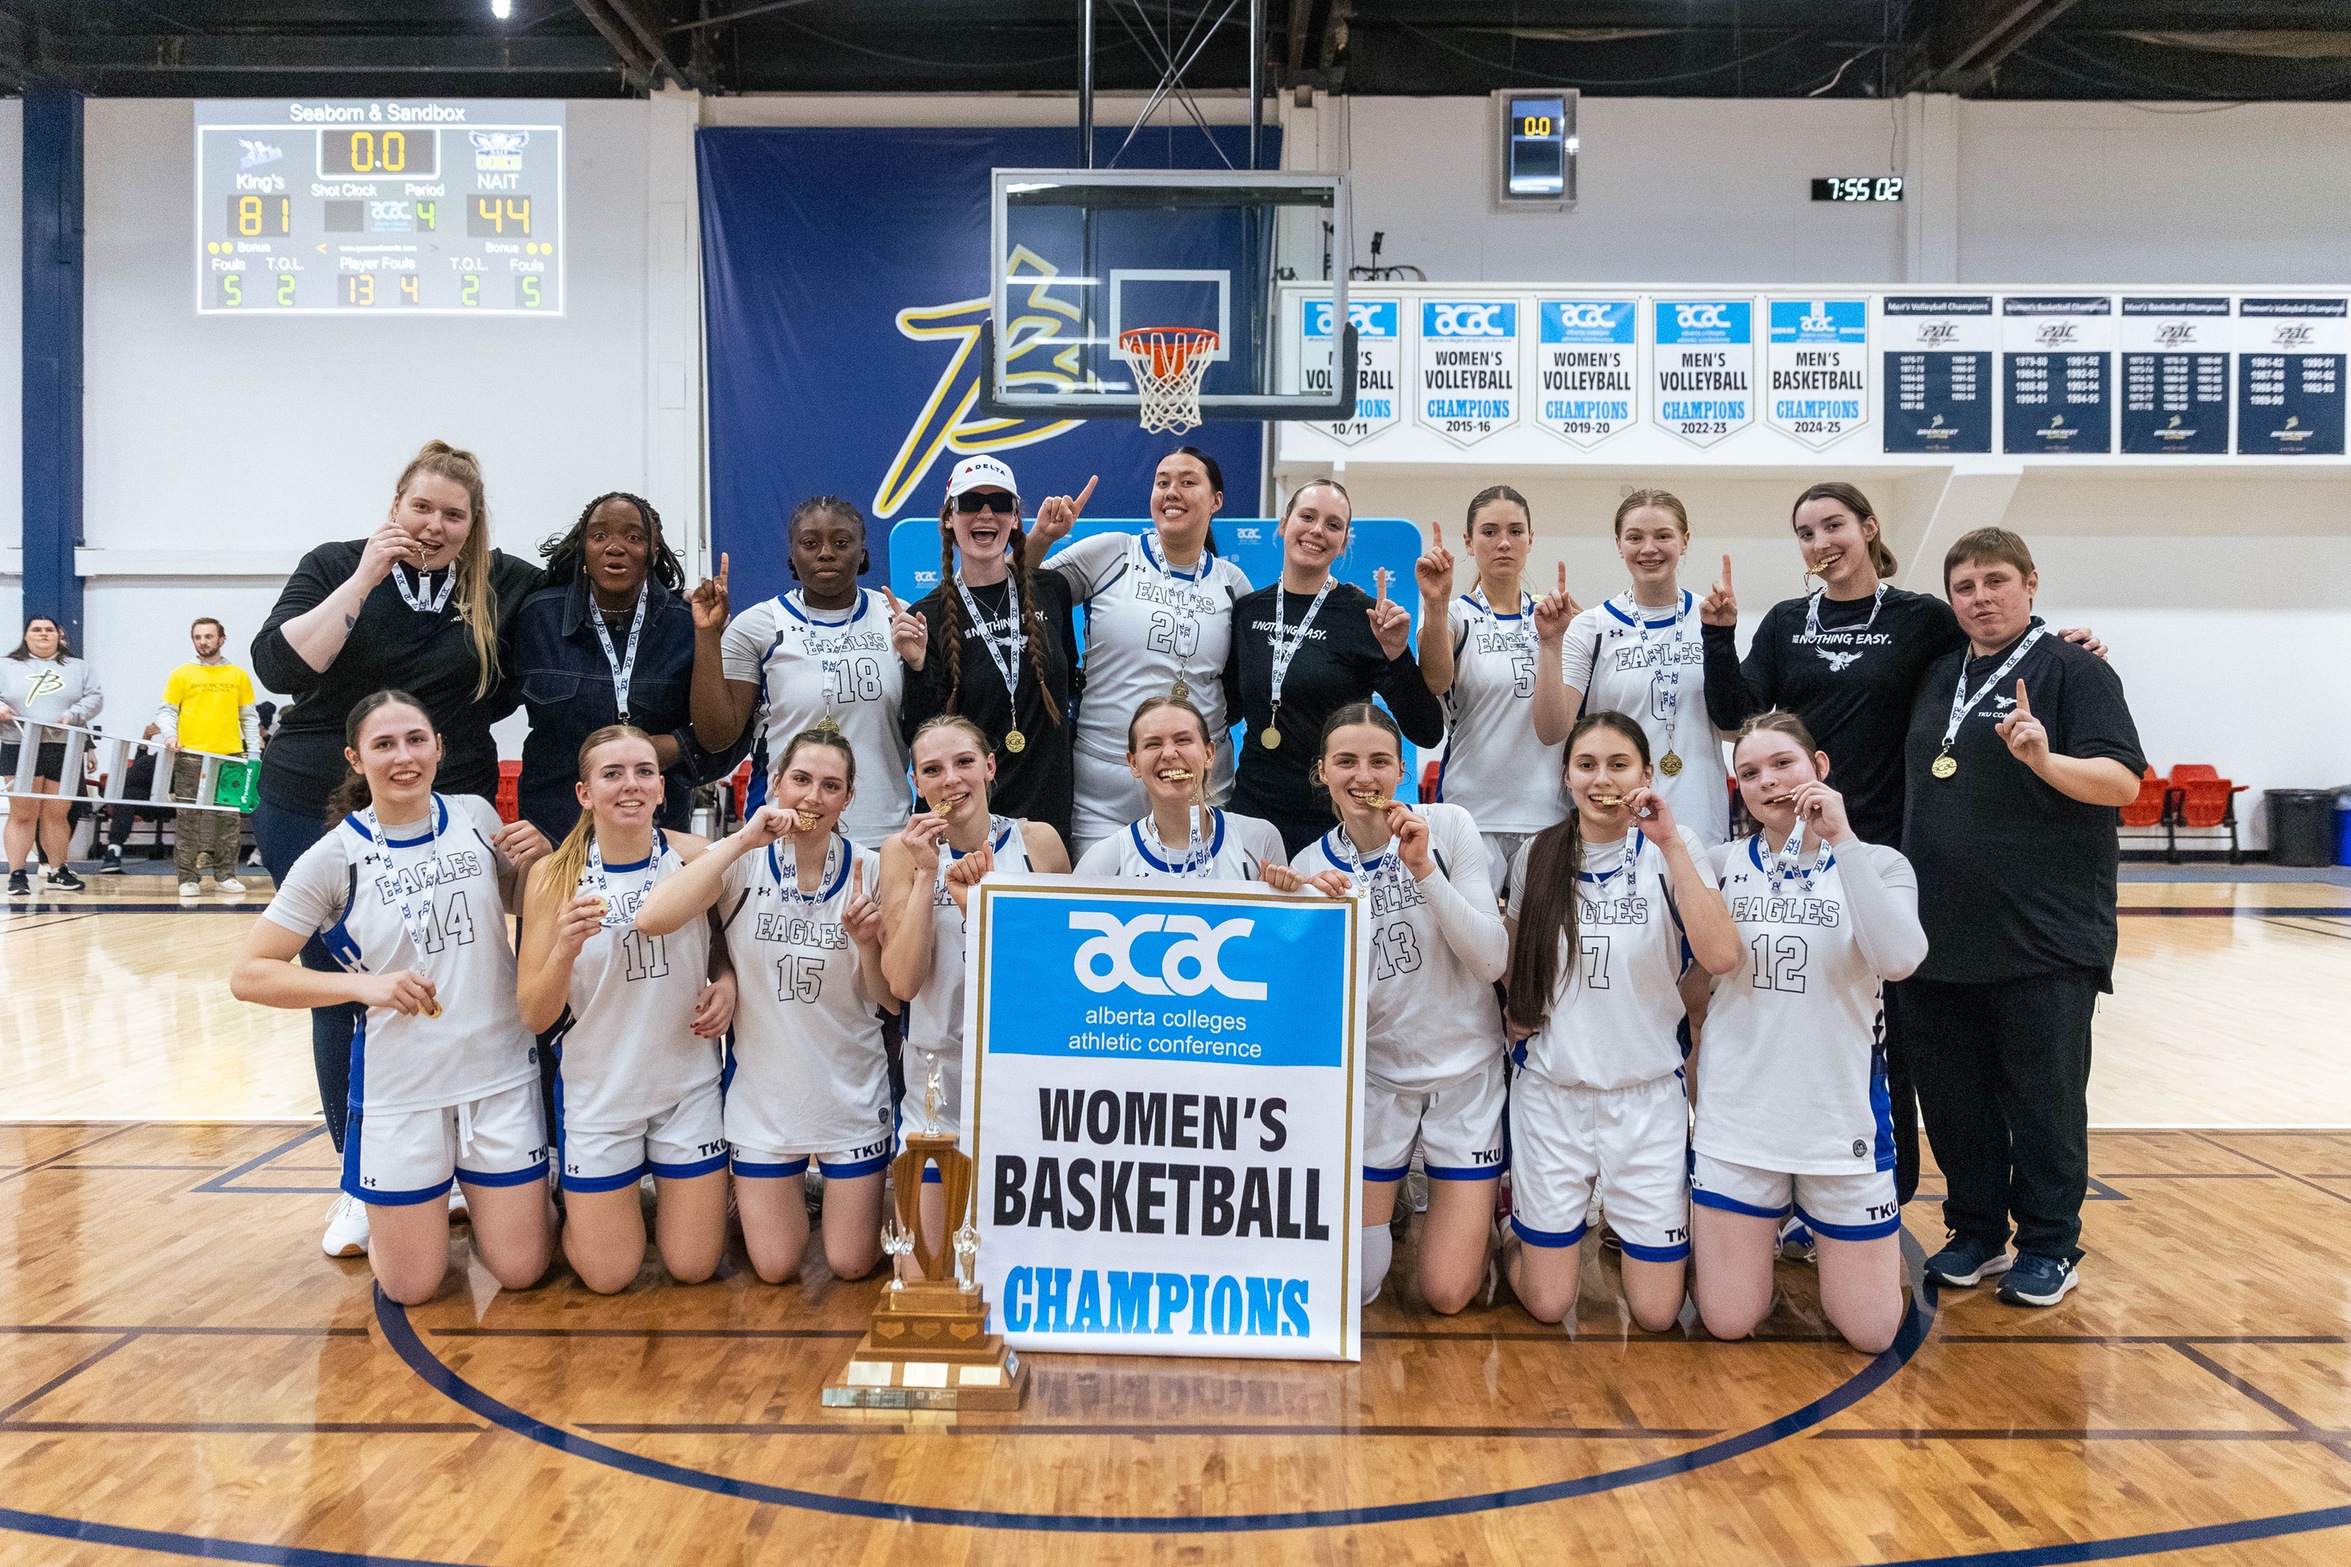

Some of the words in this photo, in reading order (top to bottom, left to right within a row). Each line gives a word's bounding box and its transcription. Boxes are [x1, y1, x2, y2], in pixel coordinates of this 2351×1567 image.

[290, 103, 364, 121] Seaborn
[369, 103, 382, 121] &
[387, 103, 466, 121] Sandbox
[1524, 116, 1550, 136] 0.0
[351, 131, 405, 172] 0.0
[236, 173, 285, 193] King's
[311, 183, 341, 197] Shot
[342, 183, 377, 197] Clock
[405, 183, 445, 197] Period
[477, 173, 519, 190] NAIT
[1827, 178, 1870, 201] 7:55
[1875, 178, 1902, 201] 02
[239, 195, 289, 235] 81
[417, 202, 435, 230] 4
[479, 199, 530, 234] 44
[237, 242, 272, 253] Bonus
[485, 242, 519, 253] Bonus
[211, 258, 246, 271] Fouls
[339, 257, 379, 272] Player
[382, 257, 416, 270] Fouls
[509, 258, 545, 271] Fouls
[223, 275, 242, 306] 5
[277, 275, 296, 306] 2
[349, 274, 374, 306] 13
[400, 276, 419, 304] 4
[461, 275, 480, 306] 2
[522, 276, 541, 308] 5
[1435, 305, 1504, 336] acac
[1560, 304, 1616, 328] acac
[1675, 304, 1732, 328] acac
[1436, 351, 1502, 366] WOMEN'S
[1554, 352, 1621, 367] WOMEN'S
[1682, 353, 1726, 367] MEN'S
[1796, 352, 1840, 366] MEN'S
[1306, 369, 1394, 389] VOLBALL
[1425, 370, 1512, 389] VOLLEYBALL
[1544, 371, 1631, 391] VOLLEYBALL
[1660, 371, 1747, 391] VOLLEYBALL
[1773, 371, 1863, 390] BASKETBALL
[1428, 400, 1510, 418] CHAMPIONS
[1546, 400, 1628, 419] CHAMPIONS
[1663, 401, 1745, 420] CHAMPIONS
[1776, 400, 1858, 419] CHAMPIONS
[1332, 423, 1368, 435] 10/11
[1446, 421, 1491, 432] 2015-16
[1564, 422, 1610, 433] 2019-20
[1681, 422, 1727, 433] 2022-23
[1794, 422, 1841, 433] 2024-25
[975, 463, 1006, 476] DELTA
[1147, 610, 1200, 659] 20
[1304, 628, 1327, 640] ASY.
[1855, 633, 1892, 646] EASY.
[836, 657, 882, 704] 18
[1511, 656, 1537, 699] 5
[1576, 897, 1648, 924] GLES
[1731, 896, 1840, 928] EAGLES
[418, 891, 475, 955] 14
[755, 912, 849, 950] EAGLES
[622, 929, 669, 982] 11
[1068, 910, 1268, 1001] acac
[1372, 921, 1423, 981] 13
[1580, 936, 1610, 990] 7
[1751, 933, 1808, 994] 12
[776, 954, 825, 1004] 15
[1085, 1007, 1155, 1027] alberta
[1162, 1009, 1247, 1034] colleges
[1068, 1032, 1141, 1052] athletic
[1147, 1034, 1262, 1058] conference
[1039, 1087, 1287, 1152] WOMEN'S
[697, 1137, 727, 1158] TKU
[850, 1140, 884, 1160] TKU
[1471, 1148, 1501, 1165] TKU
[993, 1154, 1329, 1242] BASKETBALL
[1866, 1199, 1898, 1221] TKU
[1003, 1264, 1311, 1338] CHAMPIONS
